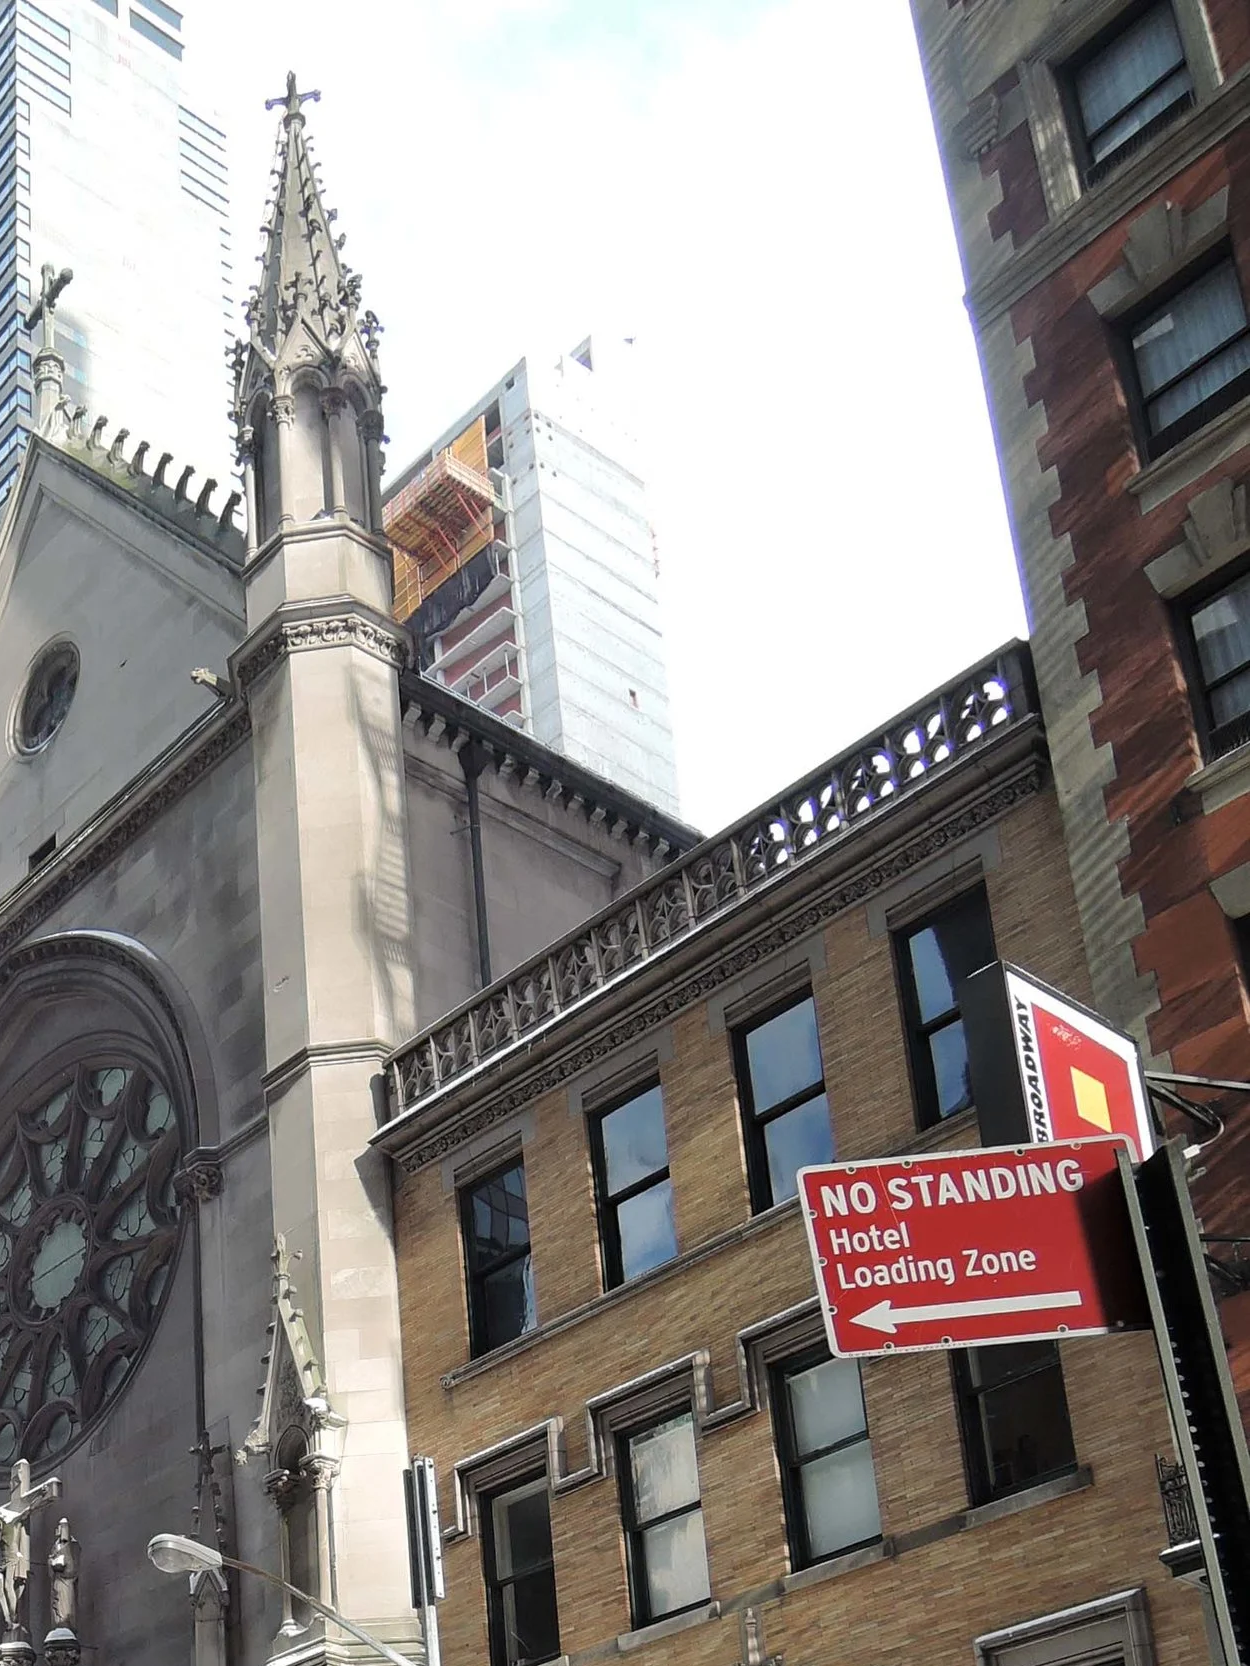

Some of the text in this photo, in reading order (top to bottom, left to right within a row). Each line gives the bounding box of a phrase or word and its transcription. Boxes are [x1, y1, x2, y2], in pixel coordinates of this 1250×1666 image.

[1014, 995, 1049, 1143] BROADWAY
[820, 1159, 1083, 1217] NO STANDING
[829, 1223, 911, 1255] Hotel
[836, 1248, 1037, 1290] Loading Zone
